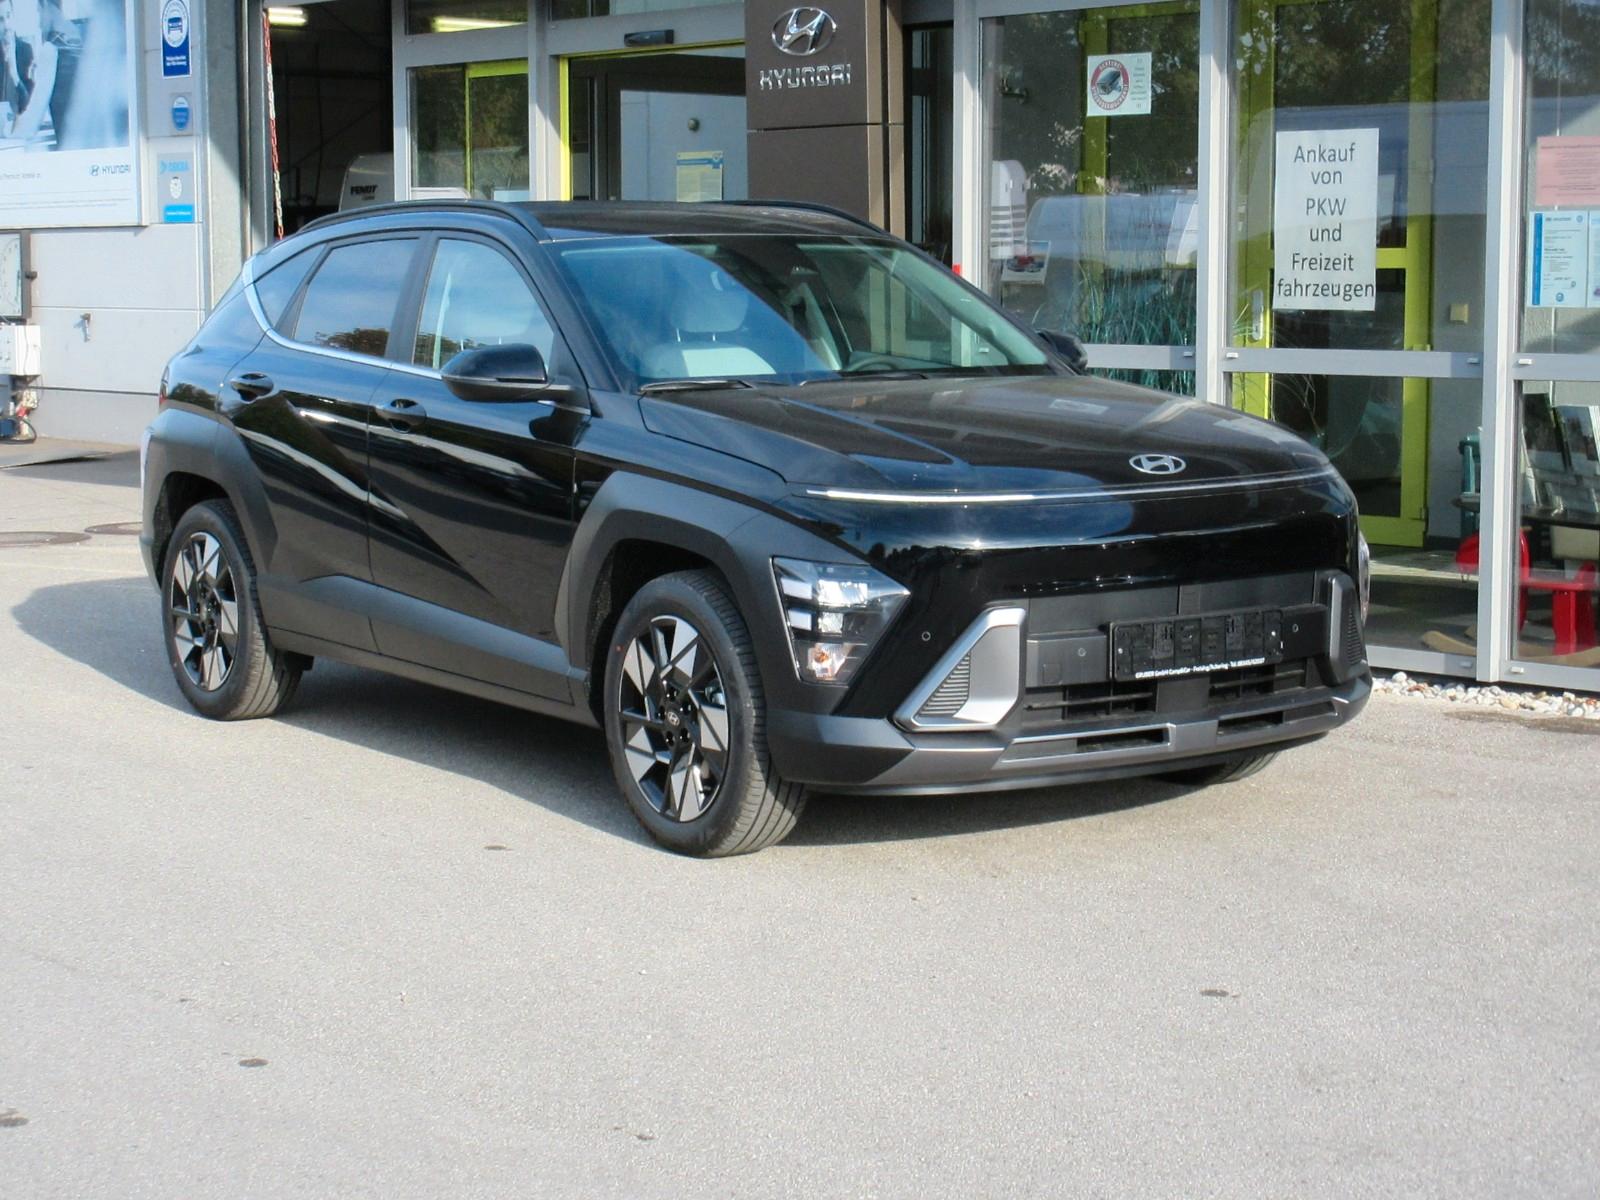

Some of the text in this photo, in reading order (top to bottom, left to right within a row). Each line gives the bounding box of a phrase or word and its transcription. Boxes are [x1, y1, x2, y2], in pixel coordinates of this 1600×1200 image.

[760, 63, 851, 90] HYUNDAI
[1294, 142, 1356, 163] Ankauf
[1311, 170, 1343, 185] von
[1306, 197, 1347, 216] PKW
[1309, 223, 1342, 242] und
[1292, 252, 1355, 271] Freizeit
[1277, 278, 1375, 302] fahrzeugen
